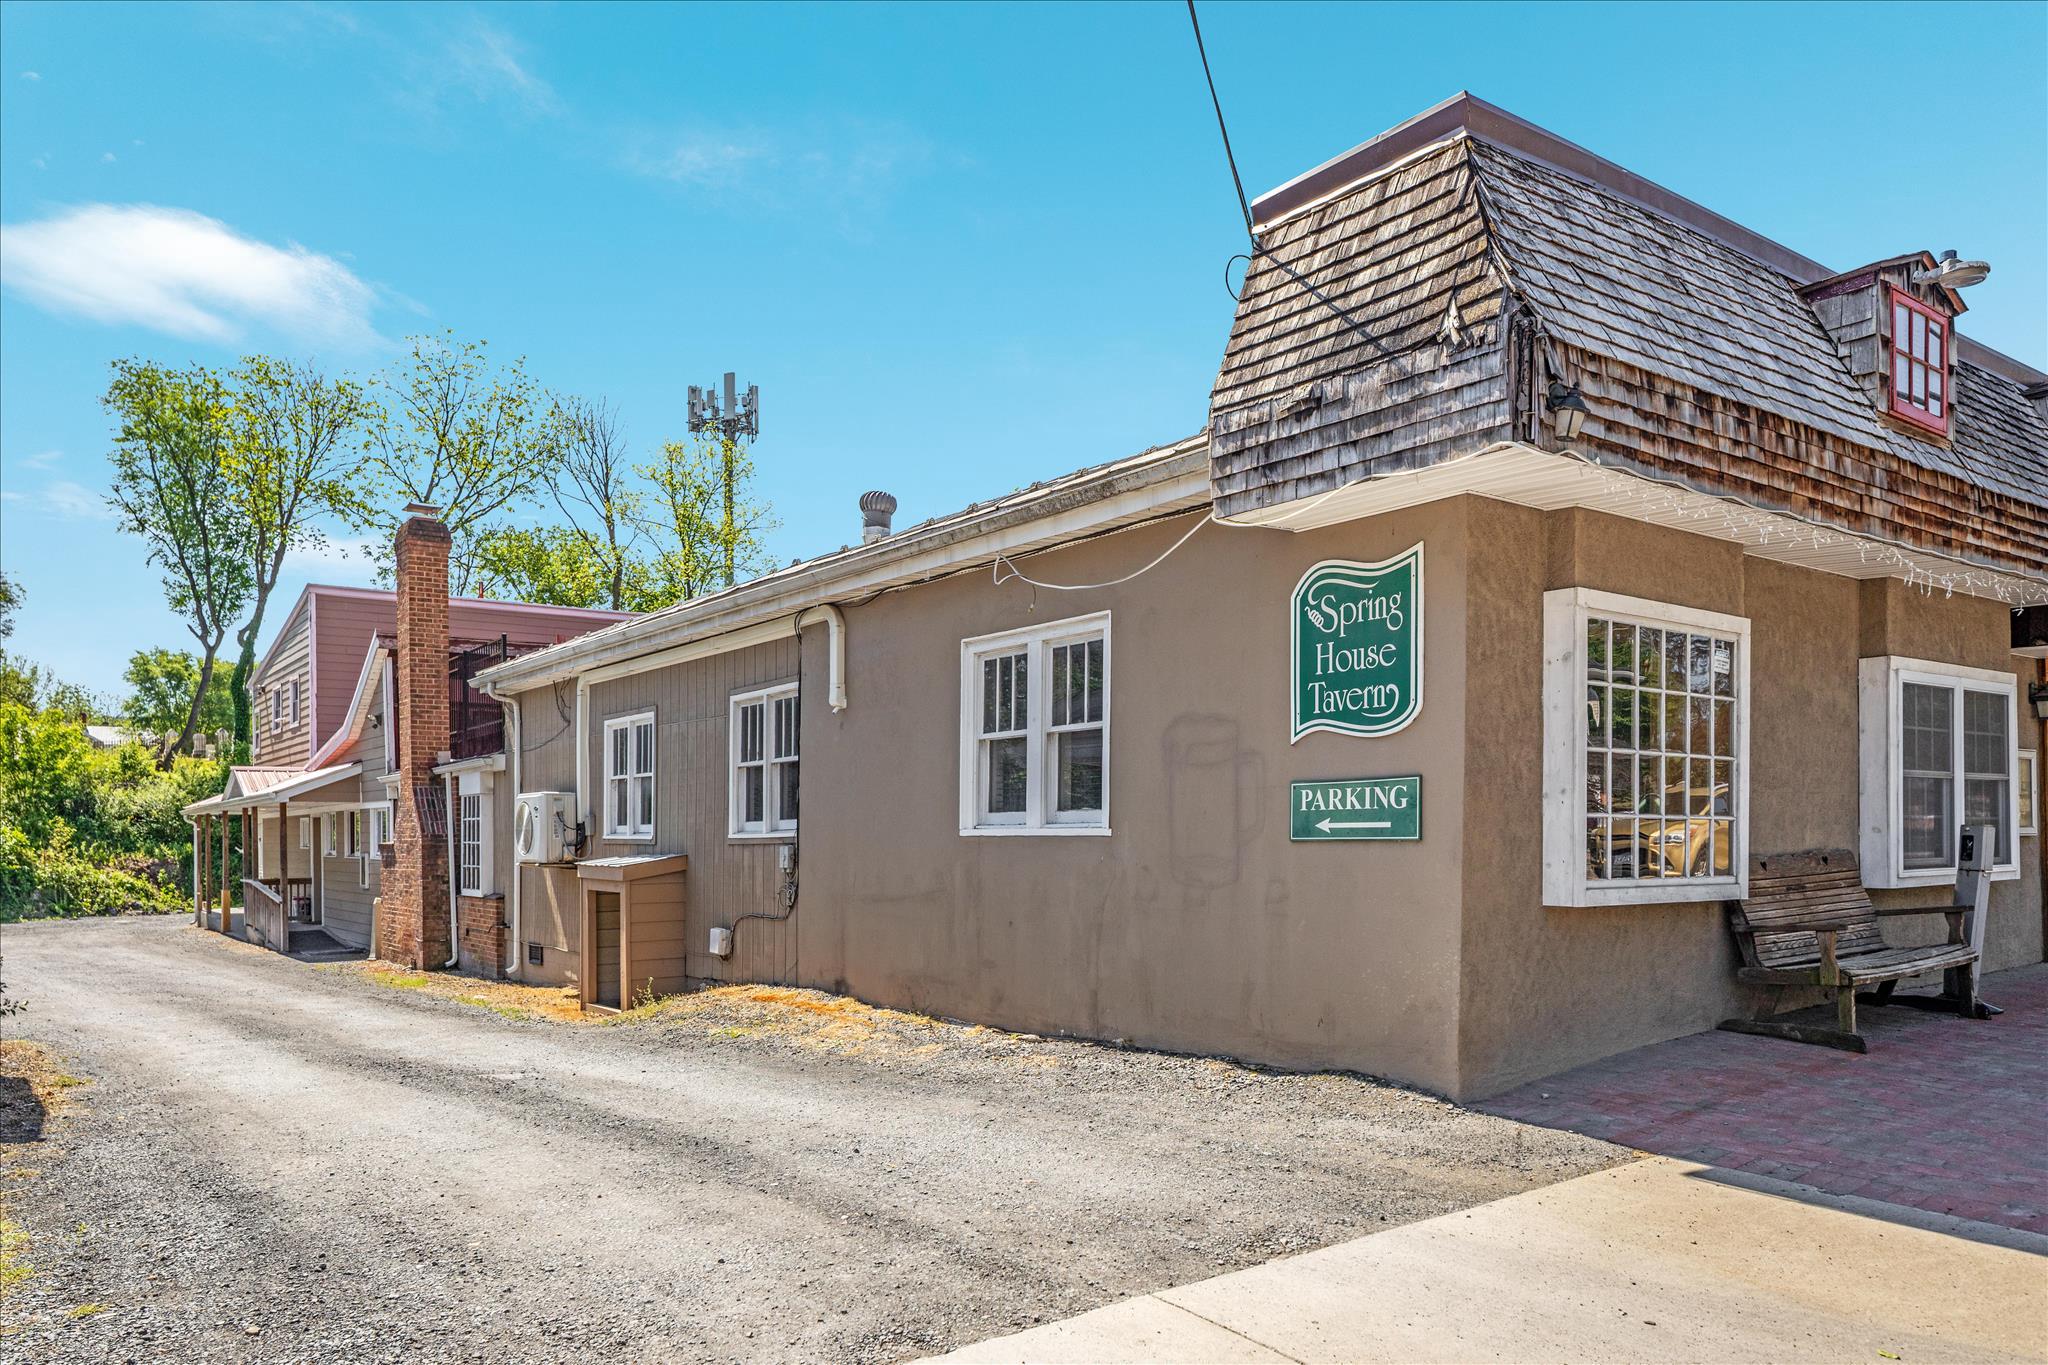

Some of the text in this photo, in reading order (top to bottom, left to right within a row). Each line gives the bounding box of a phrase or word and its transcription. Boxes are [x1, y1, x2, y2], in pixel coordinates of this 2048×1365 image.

[1304, 588, 1403, 638] Spring
[1315, 641, 1397, 675] House
[1307, 681, 1399, 718] Tavern
[1299, 784, 1409, 812] PARKING
